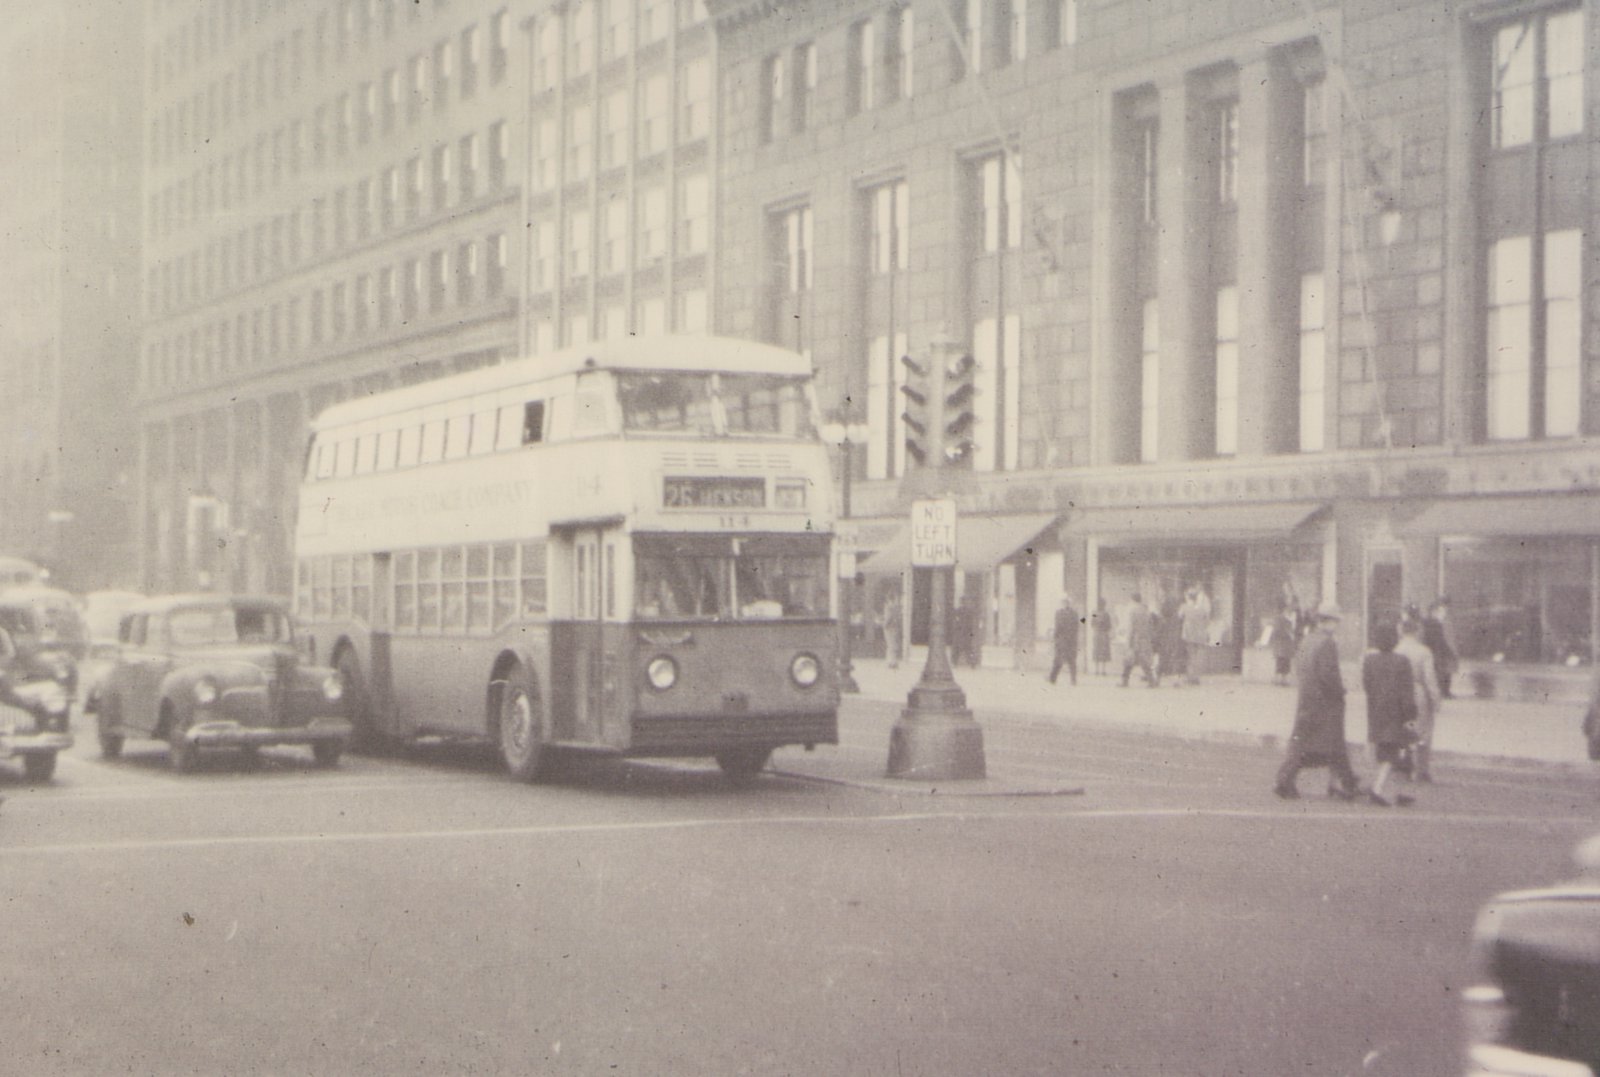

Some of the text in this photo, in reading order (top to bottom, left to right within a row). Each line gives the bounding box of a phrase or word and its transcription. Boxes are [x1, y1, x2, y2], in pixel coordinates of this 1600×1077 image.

[466, 479, 532, 510] COMPANY
[924, 506, 945, 521] NO
[915, 525, 952, 540] LEFT
[916, 543, 953, 559] TURN
